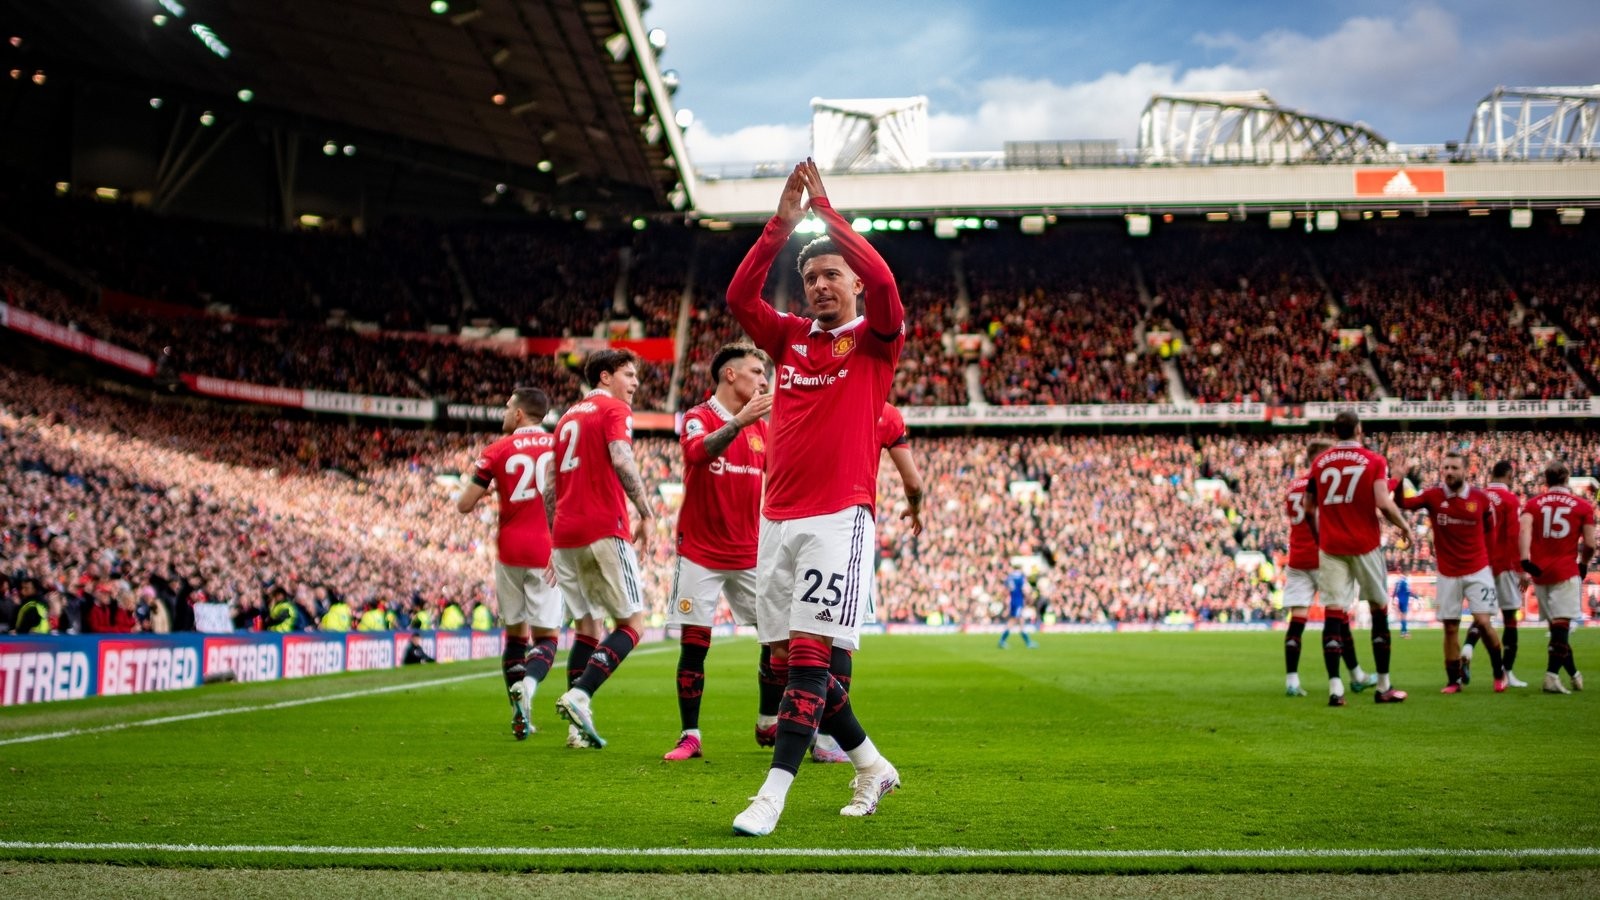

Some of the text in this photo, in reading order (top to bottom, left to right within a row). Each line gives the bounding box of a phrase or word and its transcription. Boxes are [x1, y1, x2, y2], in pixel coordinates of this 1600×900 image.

[793, 369, 849, 386] TeamVieer
[1065, 403, 1093, 417] THE
[1101, 402, 1150, 417] GREAT
[1157, 402, 1192, 416] MAN
[1389, 400, 1456, 415] NOTHING
[1466, 400, 1487, 414] ON
[1497, 400, 1549, 413] EARTH
[1558, 399, 1593, 412] LIKE
[1320, 464, 1367, 506] 27
[1541, 505, 1571, 539] 15
[800, 568, 845, 607] 25
[814, 614, 834, 623] adidas
[102, 647, 198, 697] BETFRED
[206, 643, 279, 683] BETFRED
[284, 641, 344, 678] BETFRED
[348, 638, 393, 671] BETFRED
[0, 651, 90, 706] TFRED
